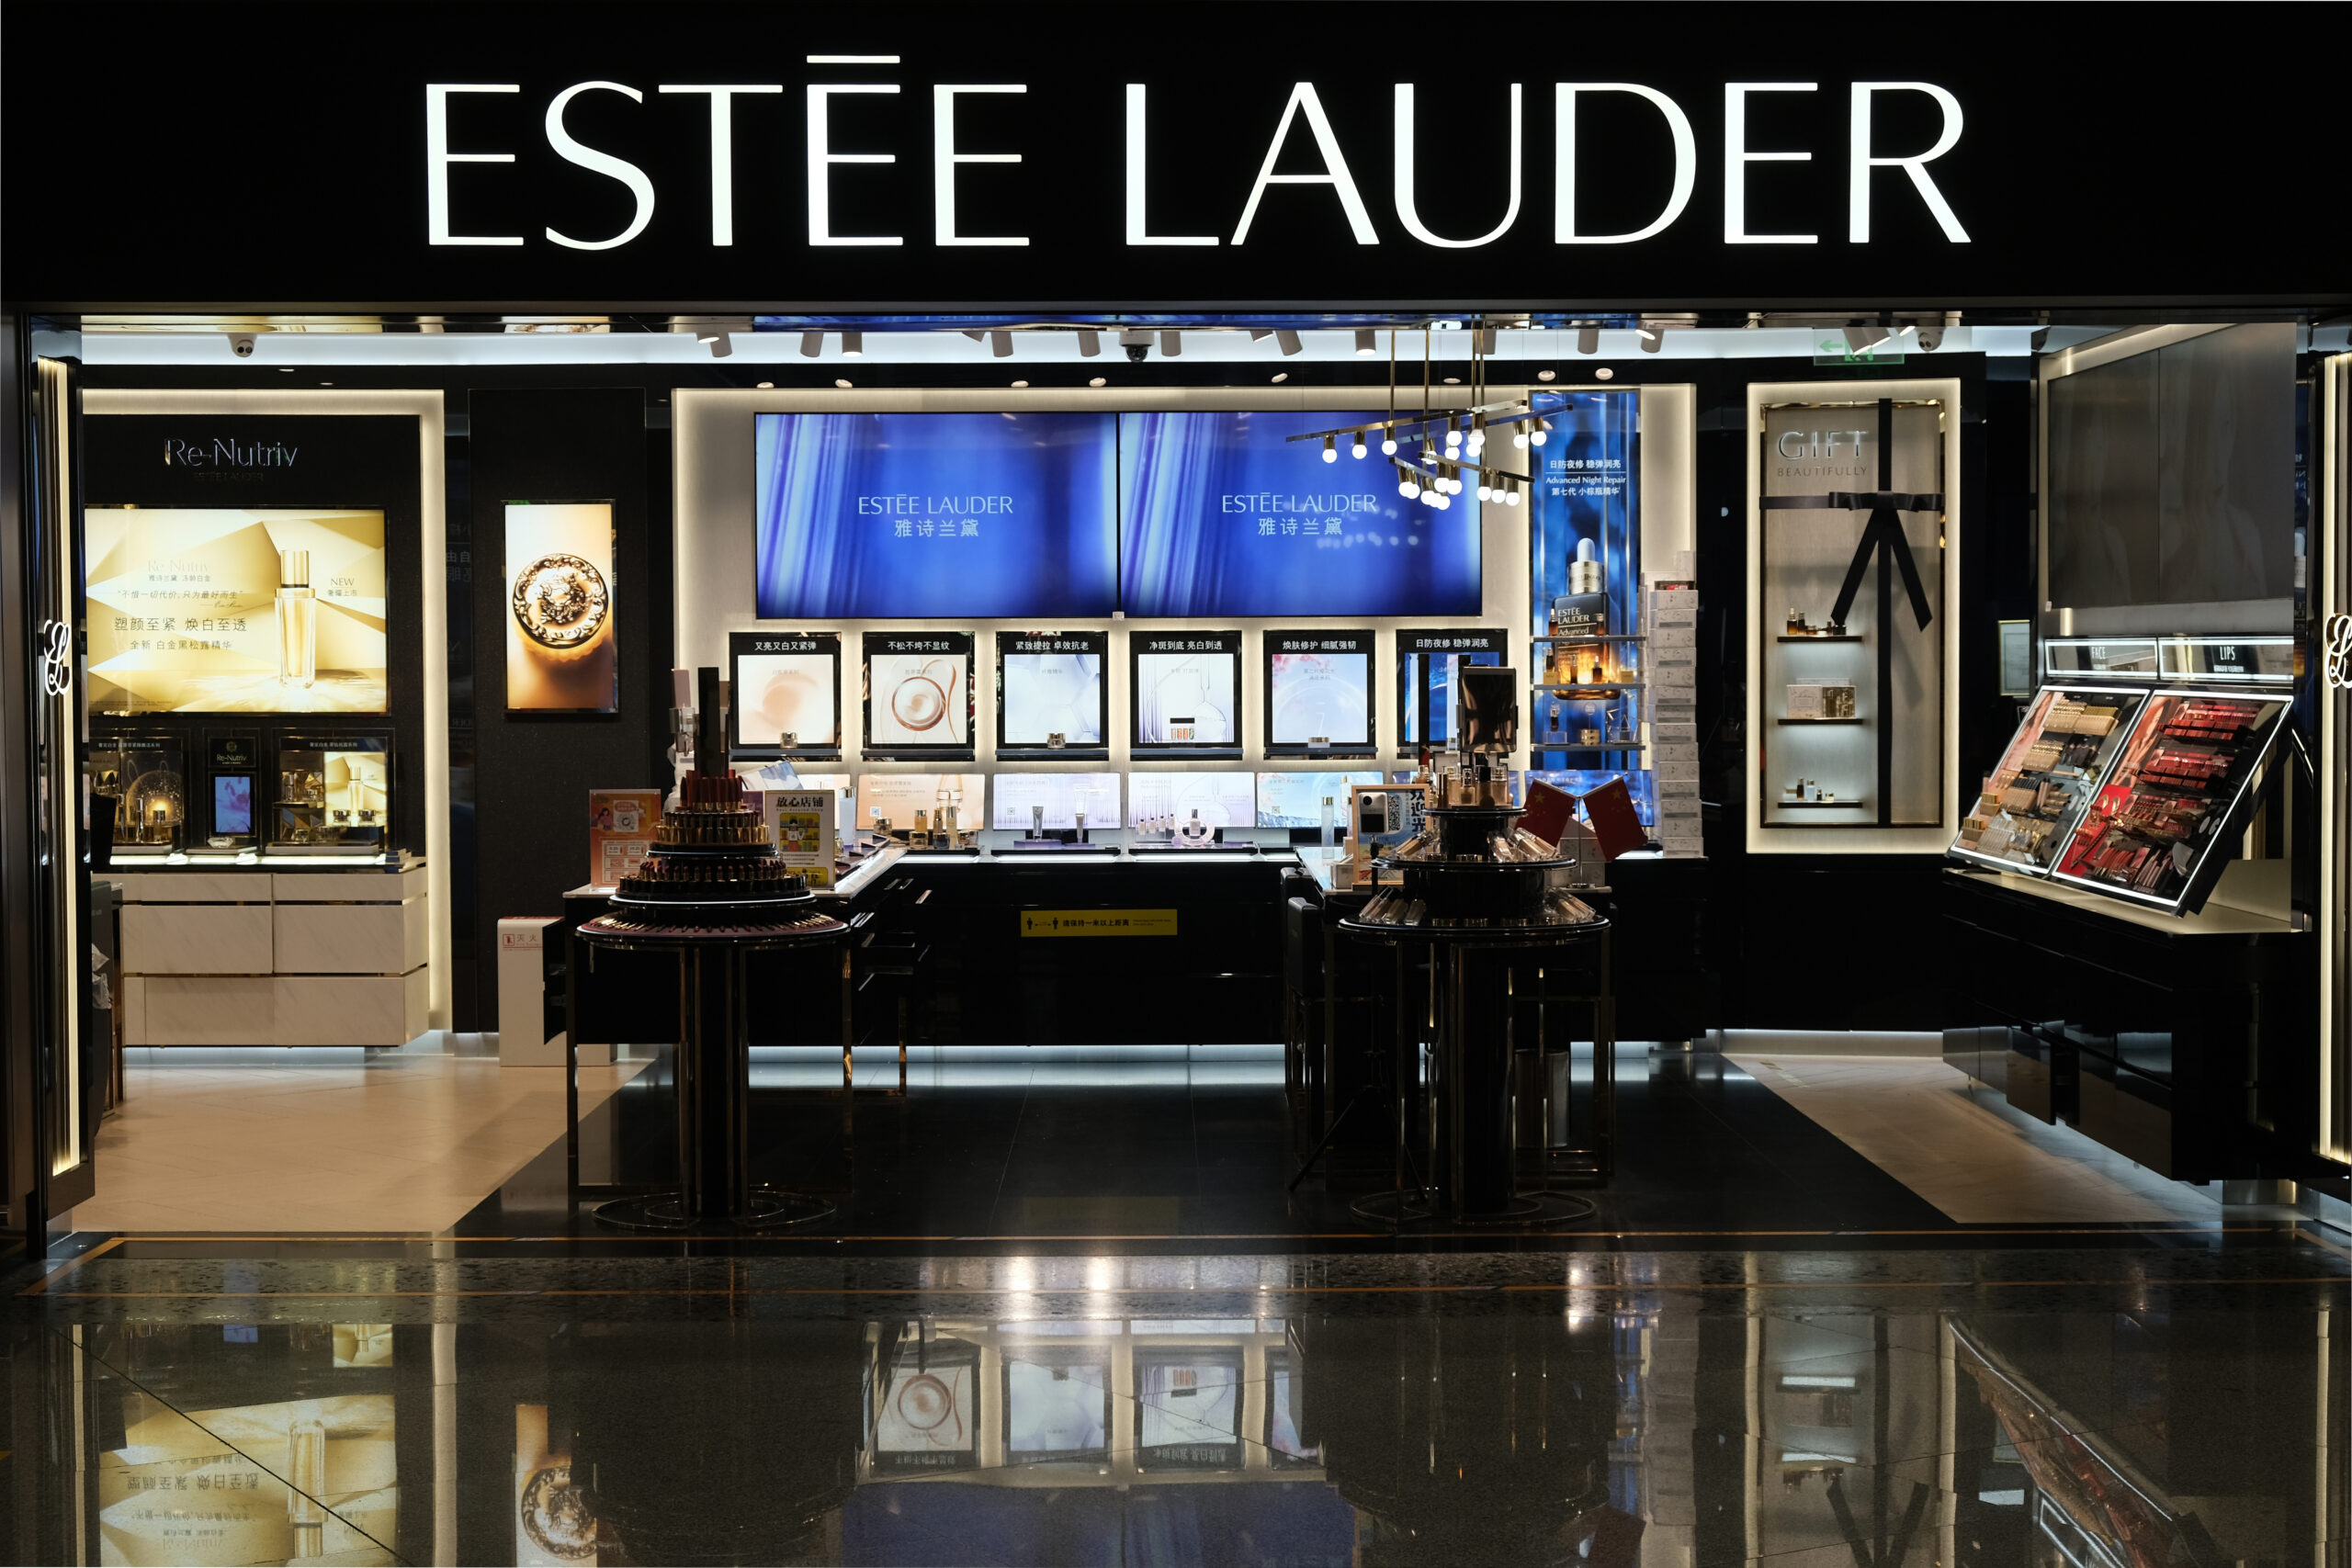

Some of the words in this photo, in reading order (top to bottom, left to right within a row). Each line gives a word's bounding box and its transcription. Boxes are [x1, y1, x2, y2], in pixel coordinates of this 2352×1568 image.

[1125, 81, 1973, 249] LAUDER
[1778, 431, 1868, 459] GIFT
[164, 438, 298, 467] Re-Nutriv
[1550, 459, 1584, 469] 日防夜修
[1586, 459, 1621, 469] 稳弹润亮
[1778, 466, 1868, 477] BEAUTIFULLY
[1582, 476, 1602, 485] Night
[1603, 476, 1626, 485] Repair
[1552, 487, 1577, 496] 第七代
[927, 496, 1013, 514] LAUDER
[1291, 494, 1377, 513] LAUDER
[894, 518, 979, 537] 雅诗兰黛
[1258, 516, 1343, 536] 雅诗兰黛
[331, 577, 355, 586] NEW
[114, 617, 176, 631] 塑颜至紧
[185, 617, 247, 632] 焕白至透
[1557, 614, 1589, 624] LAUDER
[1557, 626, 1589, 636] Advanced
[130, 640, 151, 650] 全新
[754, 641, 817, 651] 又亮又白又紧弹
[888, 641, 950, 650] 不松不垮不显纹
[1015, 641, 1051, 650] 紧致提拉
[1054, 641, 1089, 650] 卓效抗老
[1149, 640, 1184, 650] 净斑到底
[1186, 640, 1223, 650] 亮白到透
[1283, 640, 1318, 650] 焕肤修护
[1321, 640, 1357, 650] 细腻强韧
[1416, 638, 1451, 649] 日防夜修
[1453, 638, 1489, 649] 稳弹润亮
[2091, 646, 2106, 659] FACE
[2220, 646, 2235, 661] LIPS
[776, 796, 823, 807] 放心店铺
